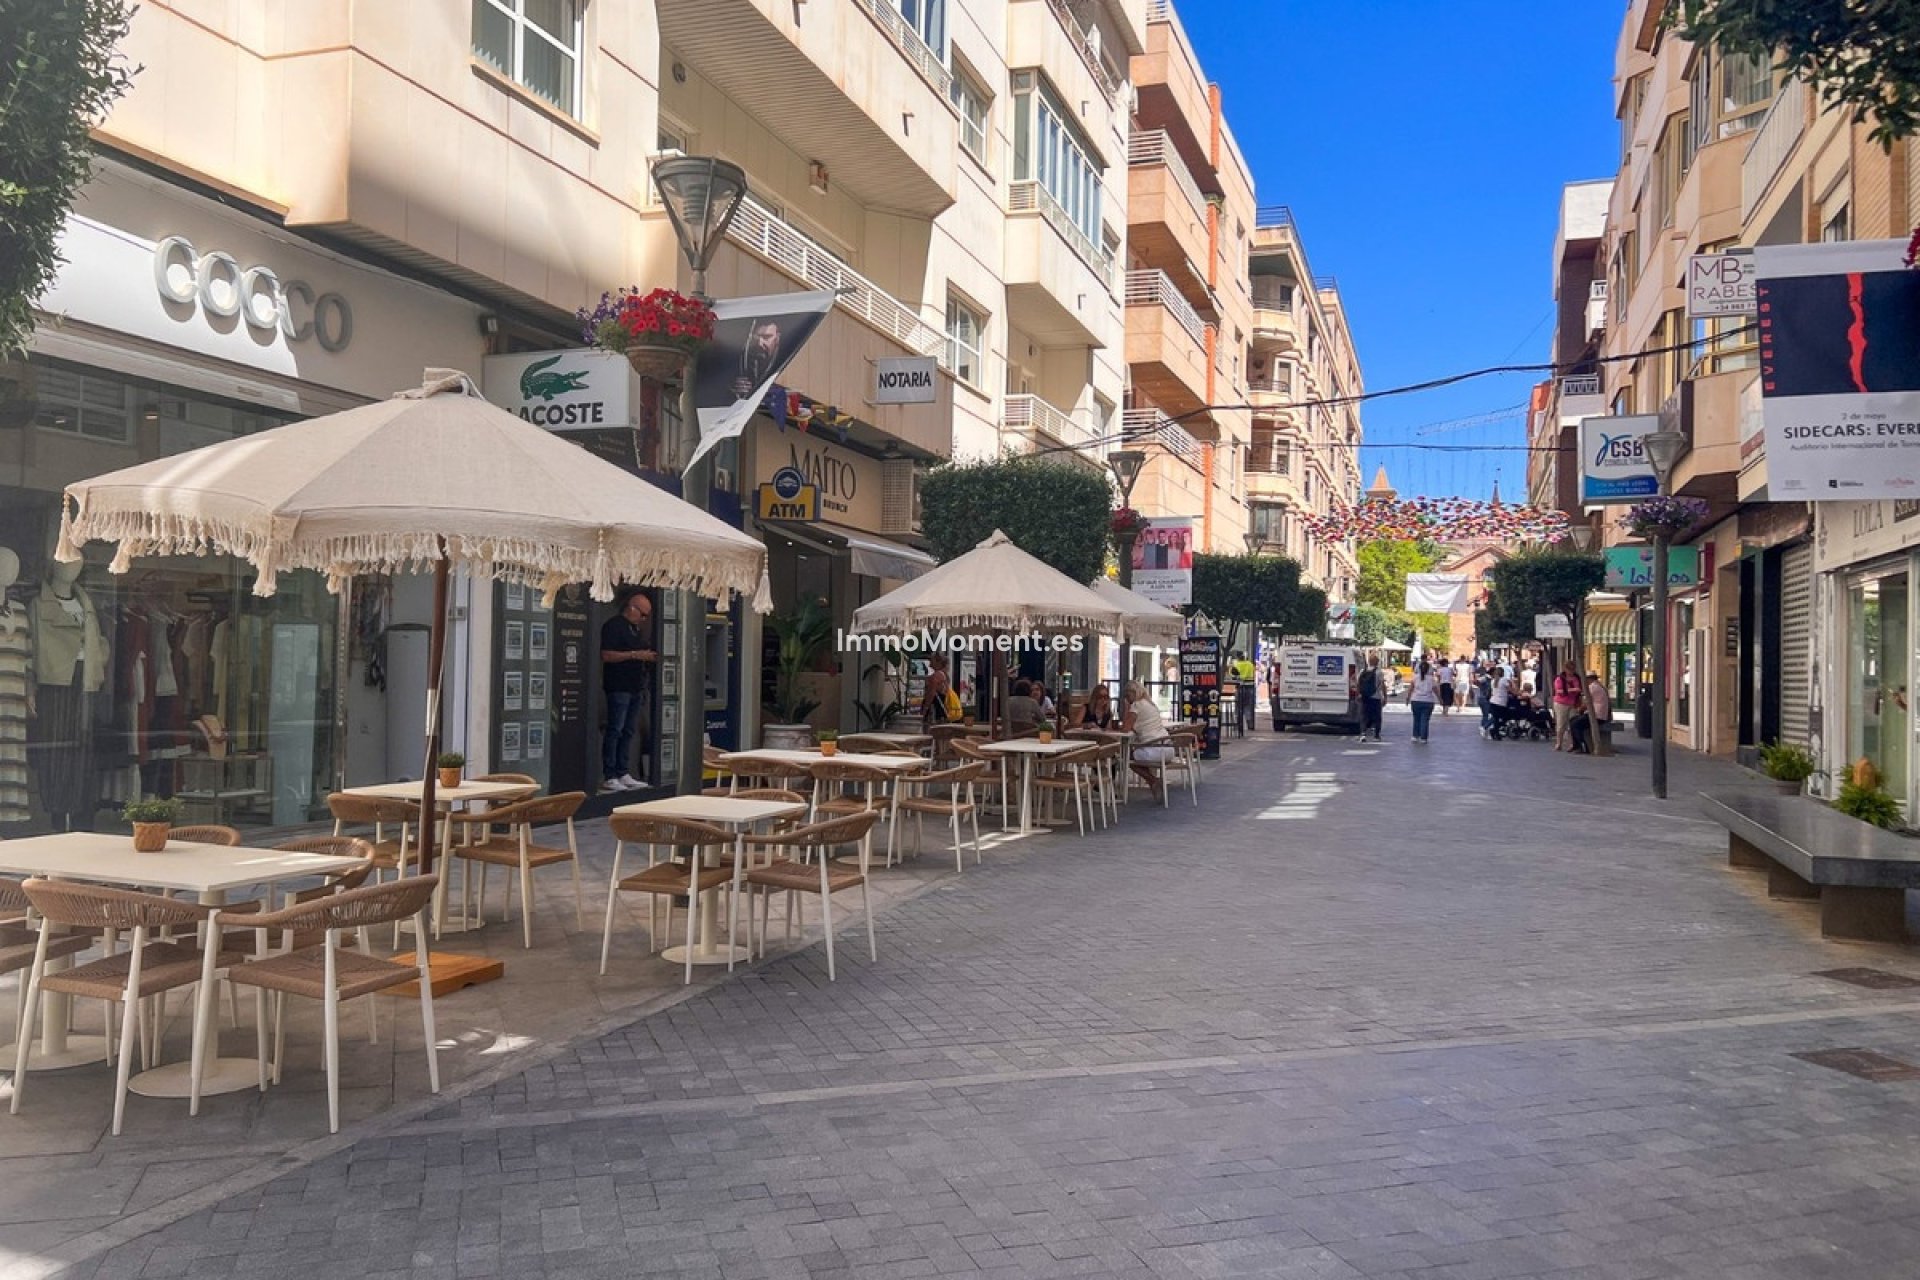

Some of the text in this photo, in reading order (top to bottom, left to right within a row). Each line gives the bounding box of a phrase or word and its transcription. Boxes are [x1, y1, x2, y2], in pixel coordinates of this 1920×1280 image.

[1694, 257, 1743, 284] MB
[879, 371, 931, 389] NOTARIA
[505, 402, 604, 426] ACOSTE
[1784, 423, 1872, 439] SIDECARS:
[1610, 441, 1643, 457] CSB
[768, 503, 806, 518] ATM
